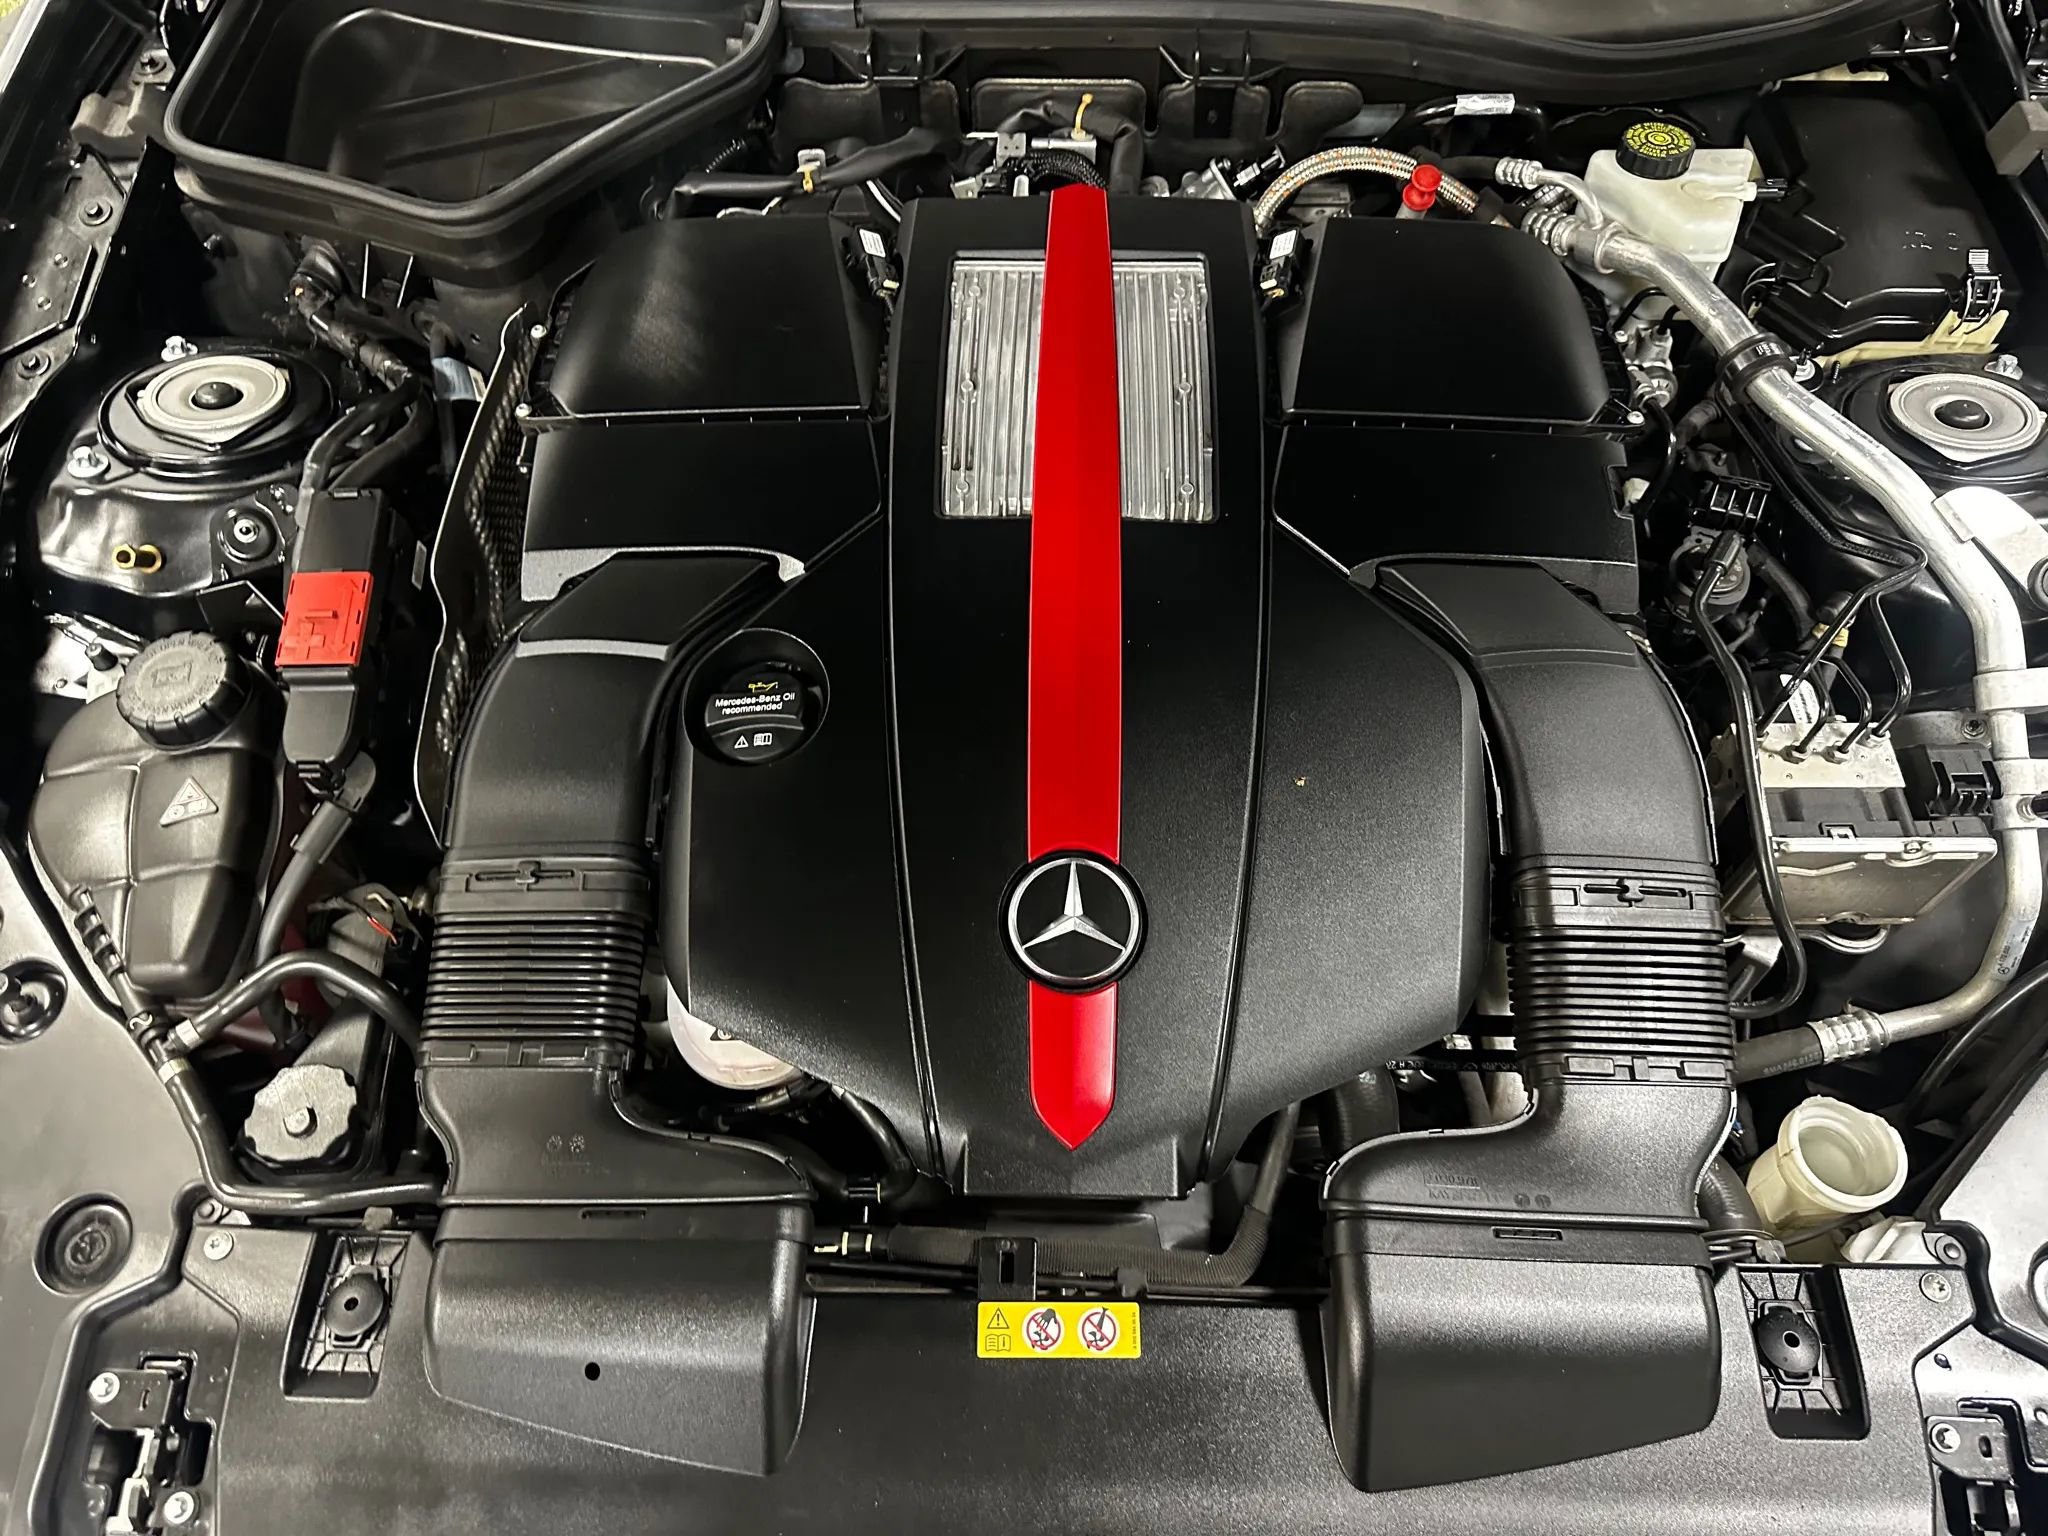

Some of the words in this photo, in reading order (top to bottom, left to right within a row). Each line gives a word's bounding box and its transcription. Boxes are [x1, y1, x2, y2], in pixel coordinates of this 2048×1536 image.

[715, 694, 781, 708] Mercedes-Benz
[783, 692, 795, 701] Oil
[722, 702, 782, 715] recommended
